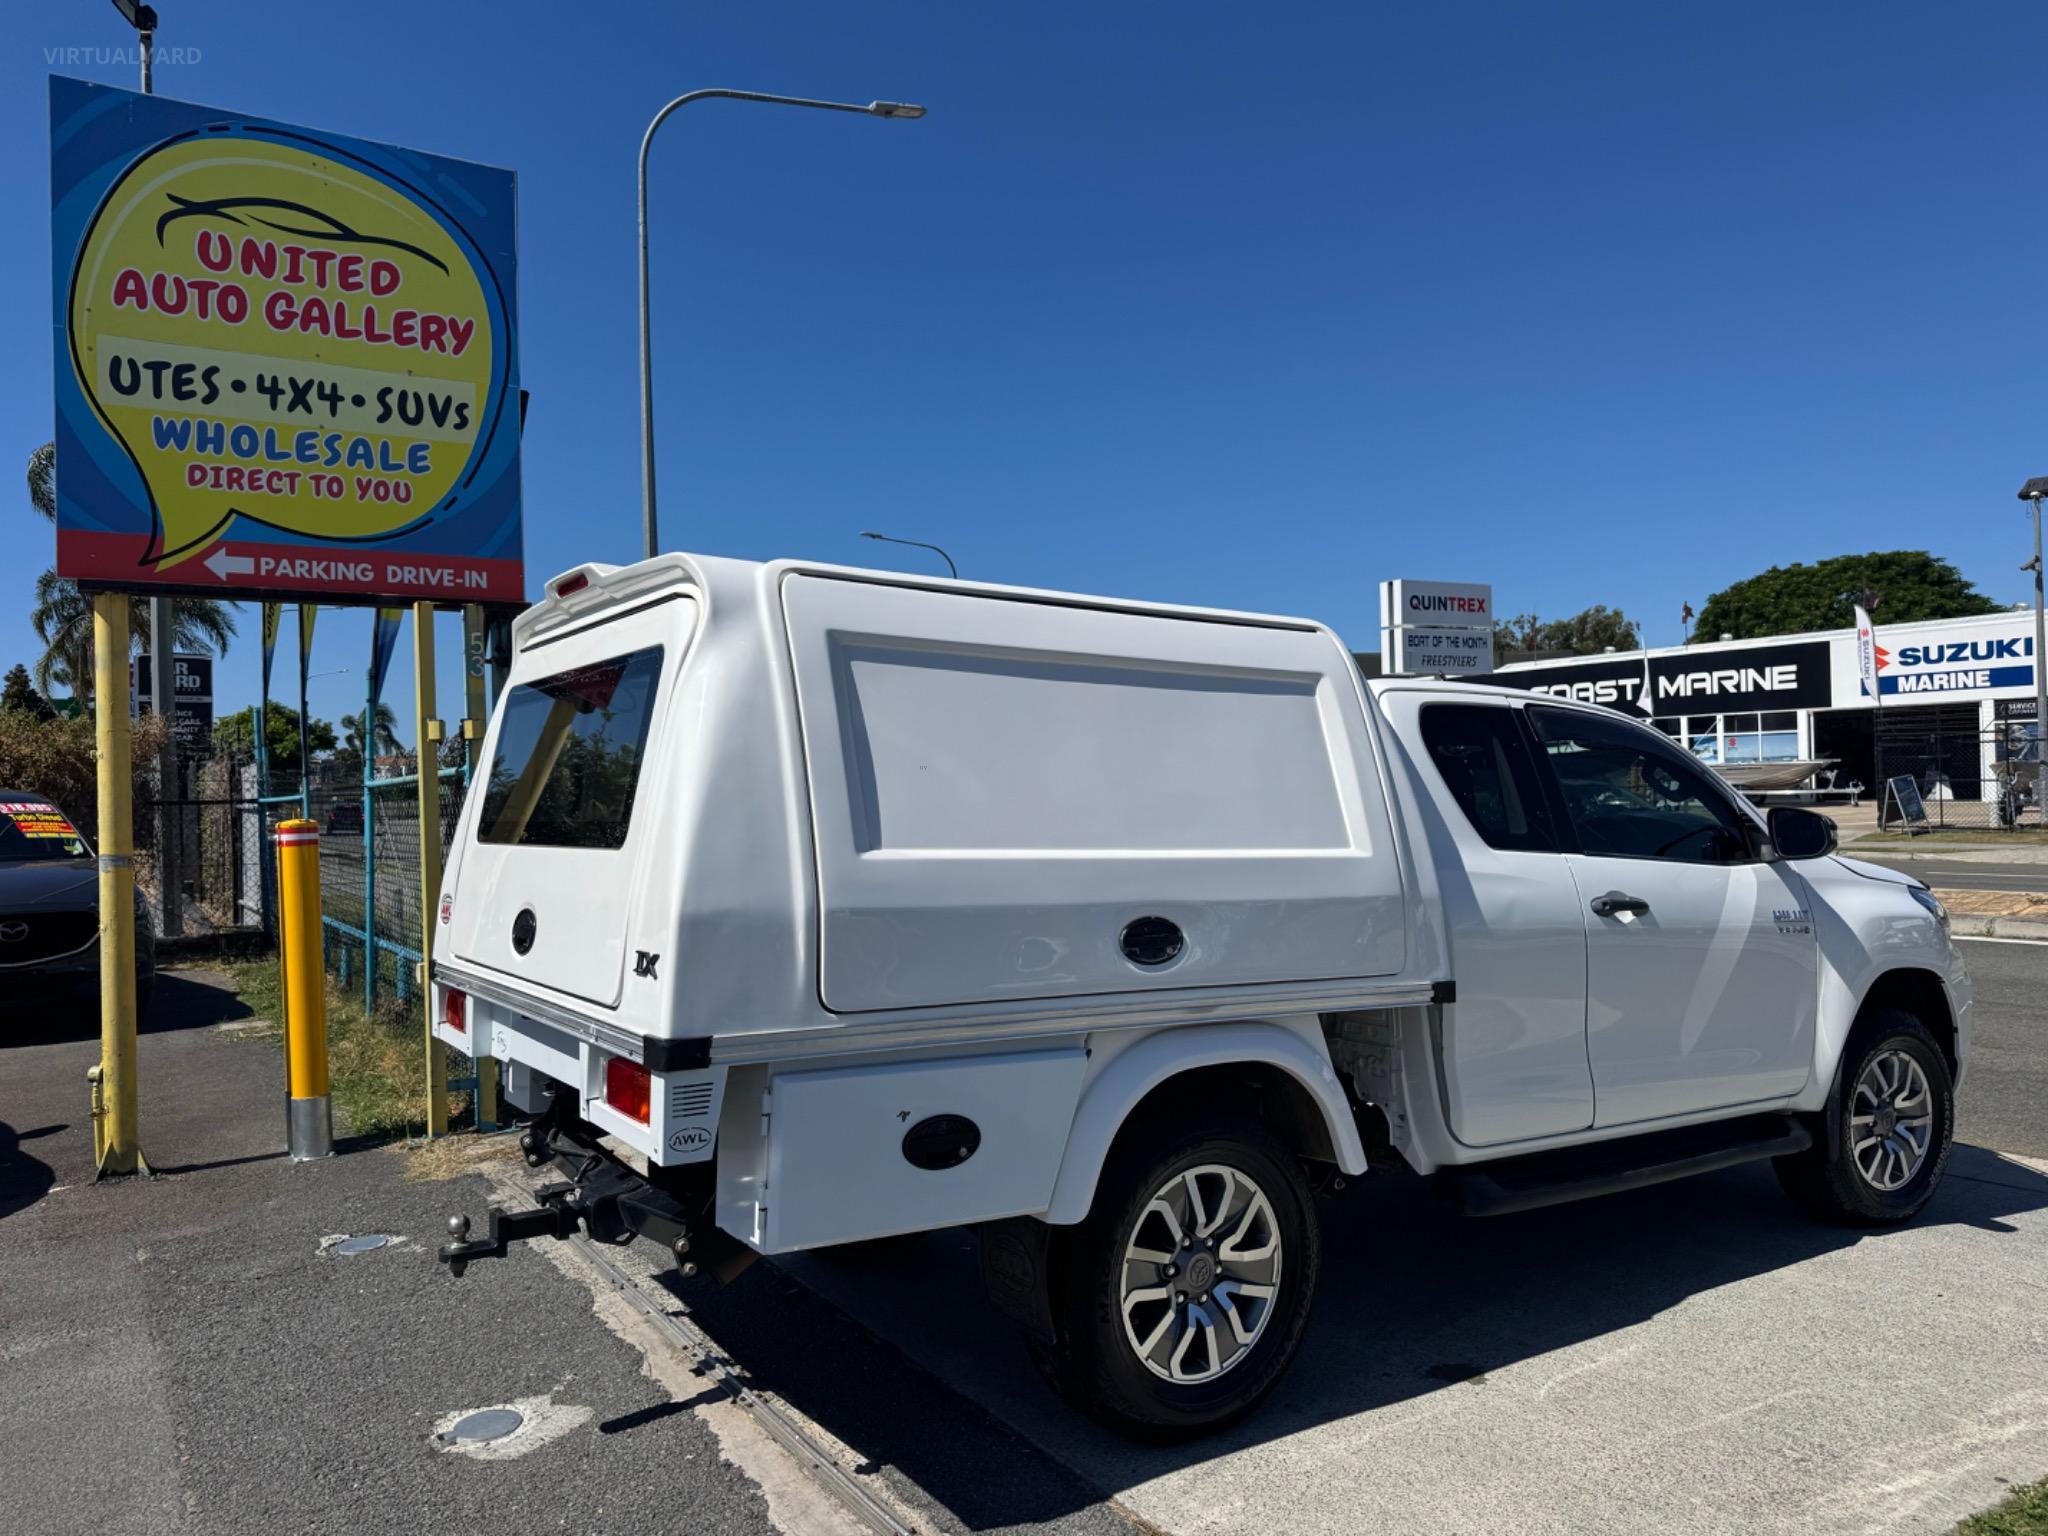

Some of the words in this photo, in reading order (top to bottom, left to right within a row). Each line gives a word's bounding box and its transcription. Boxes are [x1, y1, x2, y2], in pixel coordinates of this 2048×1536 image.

[197, 230, 402, 297] UNITED
[113, 268, 249, 325] AUTO
[264, 290, 475, 357] GALLERY
[108, 355, 221, 405] UTES
[256, 373, 345, 418] 4X4
[152, 416, 432, 474] WHOLESALE
[187, 464, 302, 496] DIRECT
[309, 474, 345, 499] TO
[356, 476, 413, 504] YOU
[260, 557, 374, 582] PARKING
[387, 566, 488, 588] DRIVE-IN
[1409, 594, 1486, 613] QUINTREX
[1446, 636, 1459, 649] THE
[1898, 636, 2034, 667] SUZUKI
[1421, 655, 1479, 668] FREESTYLERS
[1658, 664, 1798, 698] MARINE
[1897, 669, 1991, 693] MARINE
[672, 1132, 708, 1148] AWL
